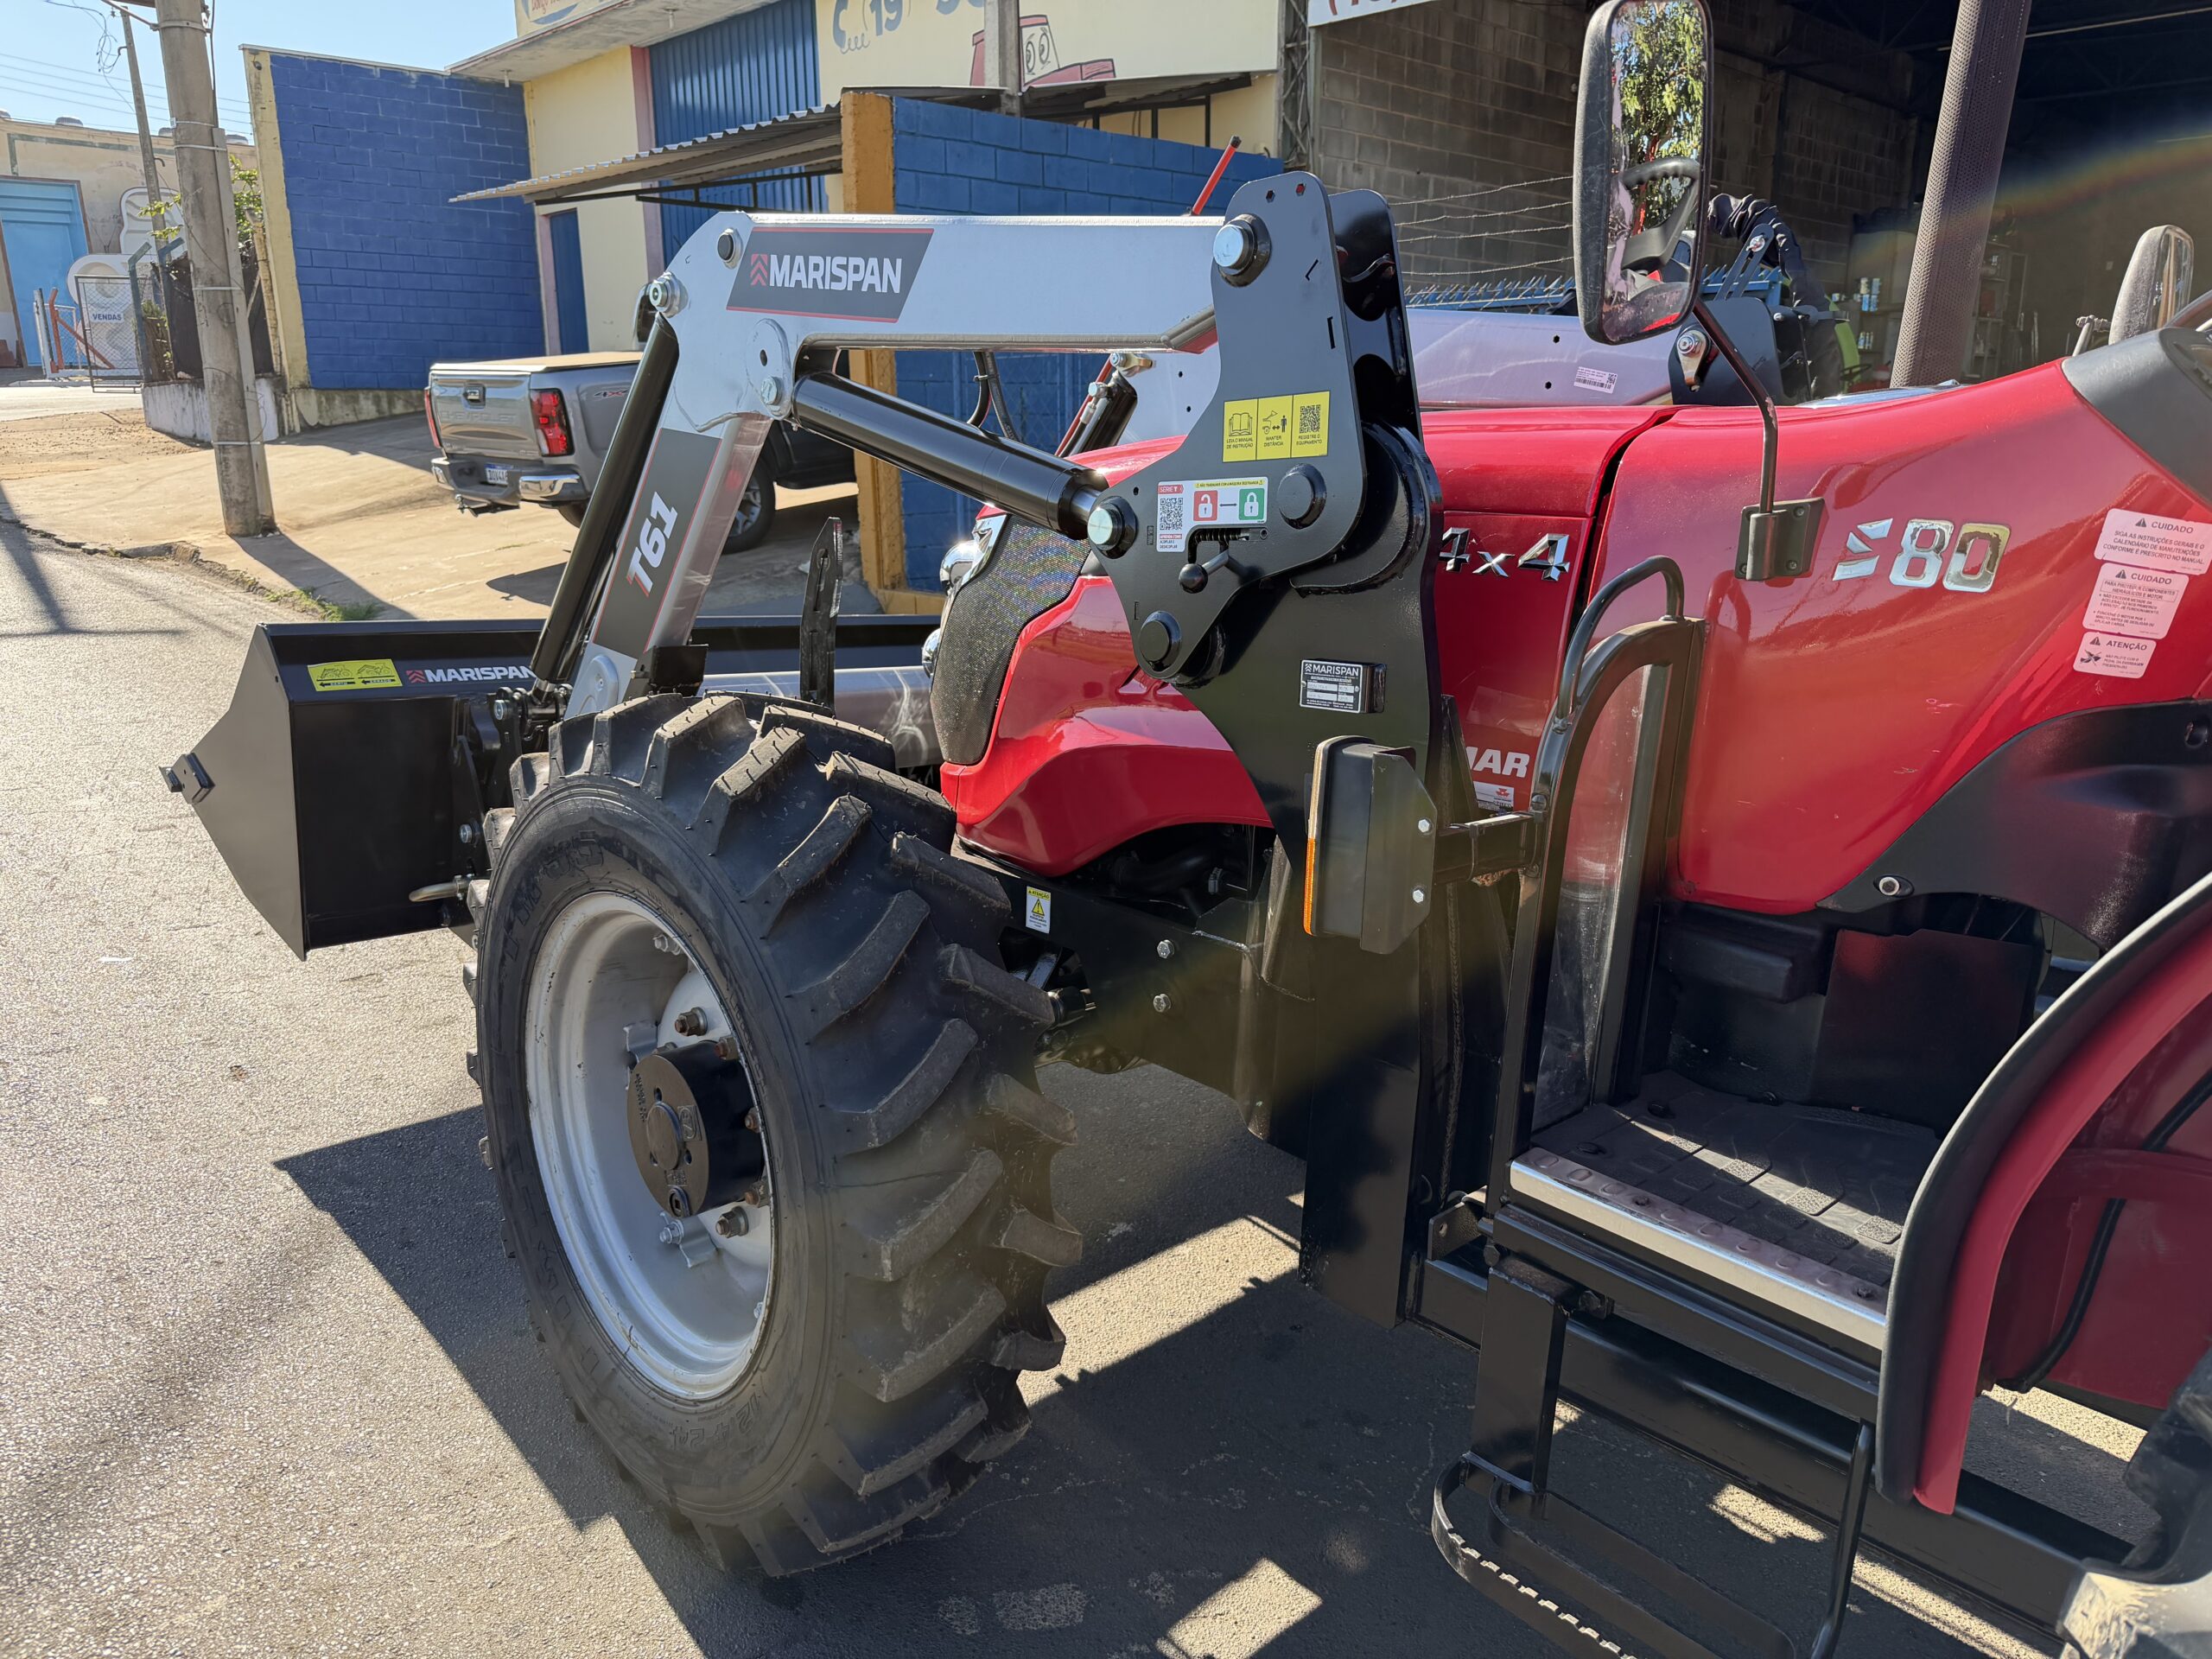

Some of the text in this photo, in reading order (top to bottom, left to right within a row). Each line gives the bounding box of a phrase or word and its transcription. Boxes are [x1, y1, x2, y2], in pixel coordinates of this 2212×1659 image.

[769, 254, 902, 294] MARISPAN
[2152, 522, 2193, 534] CUIDADO
[626, 491, 678, 598] T61
[2113, 537, 2150, 549] CALENDÁRIO
[2158, 545, 2200, 556] MANUTENÇÕES
[2138, 533, 2172, 545] INSTRUÇÕES
[2103, 543, 2134, 553] CONFORME
[2139, 550, 2172, 560] PRESCRITO
[2131, 573, 2172, 584] CUIDADO
[2107, 639, 2147, 651] ATENÇÃO
[424, 665, 537, 683] MARISPAN
[1313, 664, 1358, 677] MARISPAN
